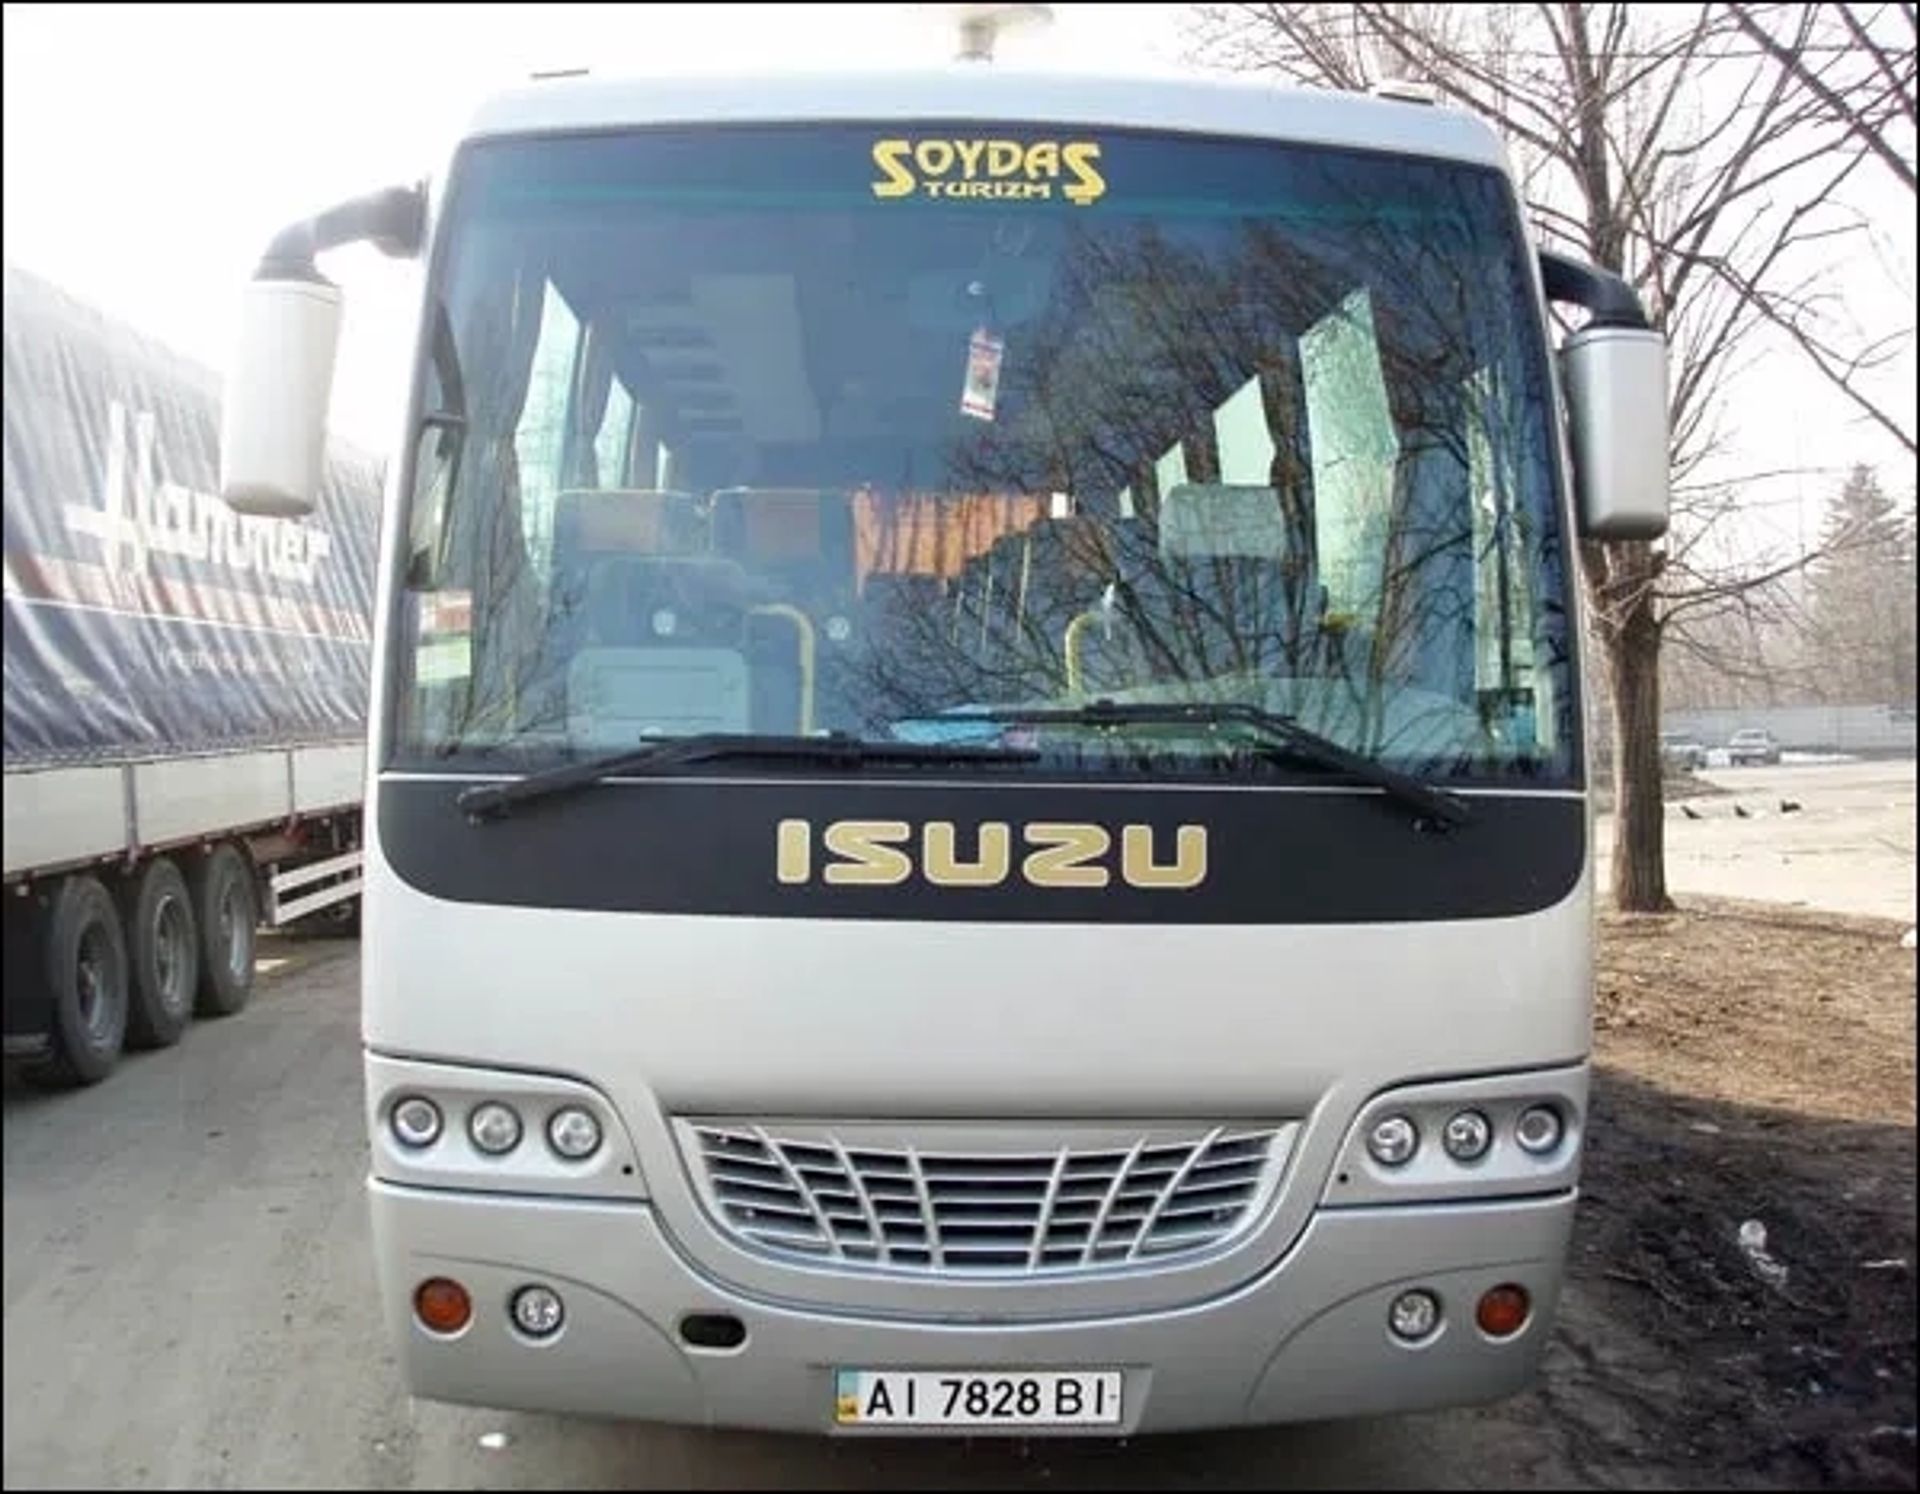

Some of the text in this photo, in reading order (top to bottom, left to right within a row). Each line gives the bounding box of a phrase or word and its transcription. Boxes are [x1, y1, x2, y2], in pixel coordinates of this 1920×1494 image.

[872, 140, 1106, 205] SOYDAŞ
[923, 181, 1050, 199] TURIZM
[777, 819, 1208, 888] ISUZU
[866, 1378, 1104, 1417] AI 7828 BI
